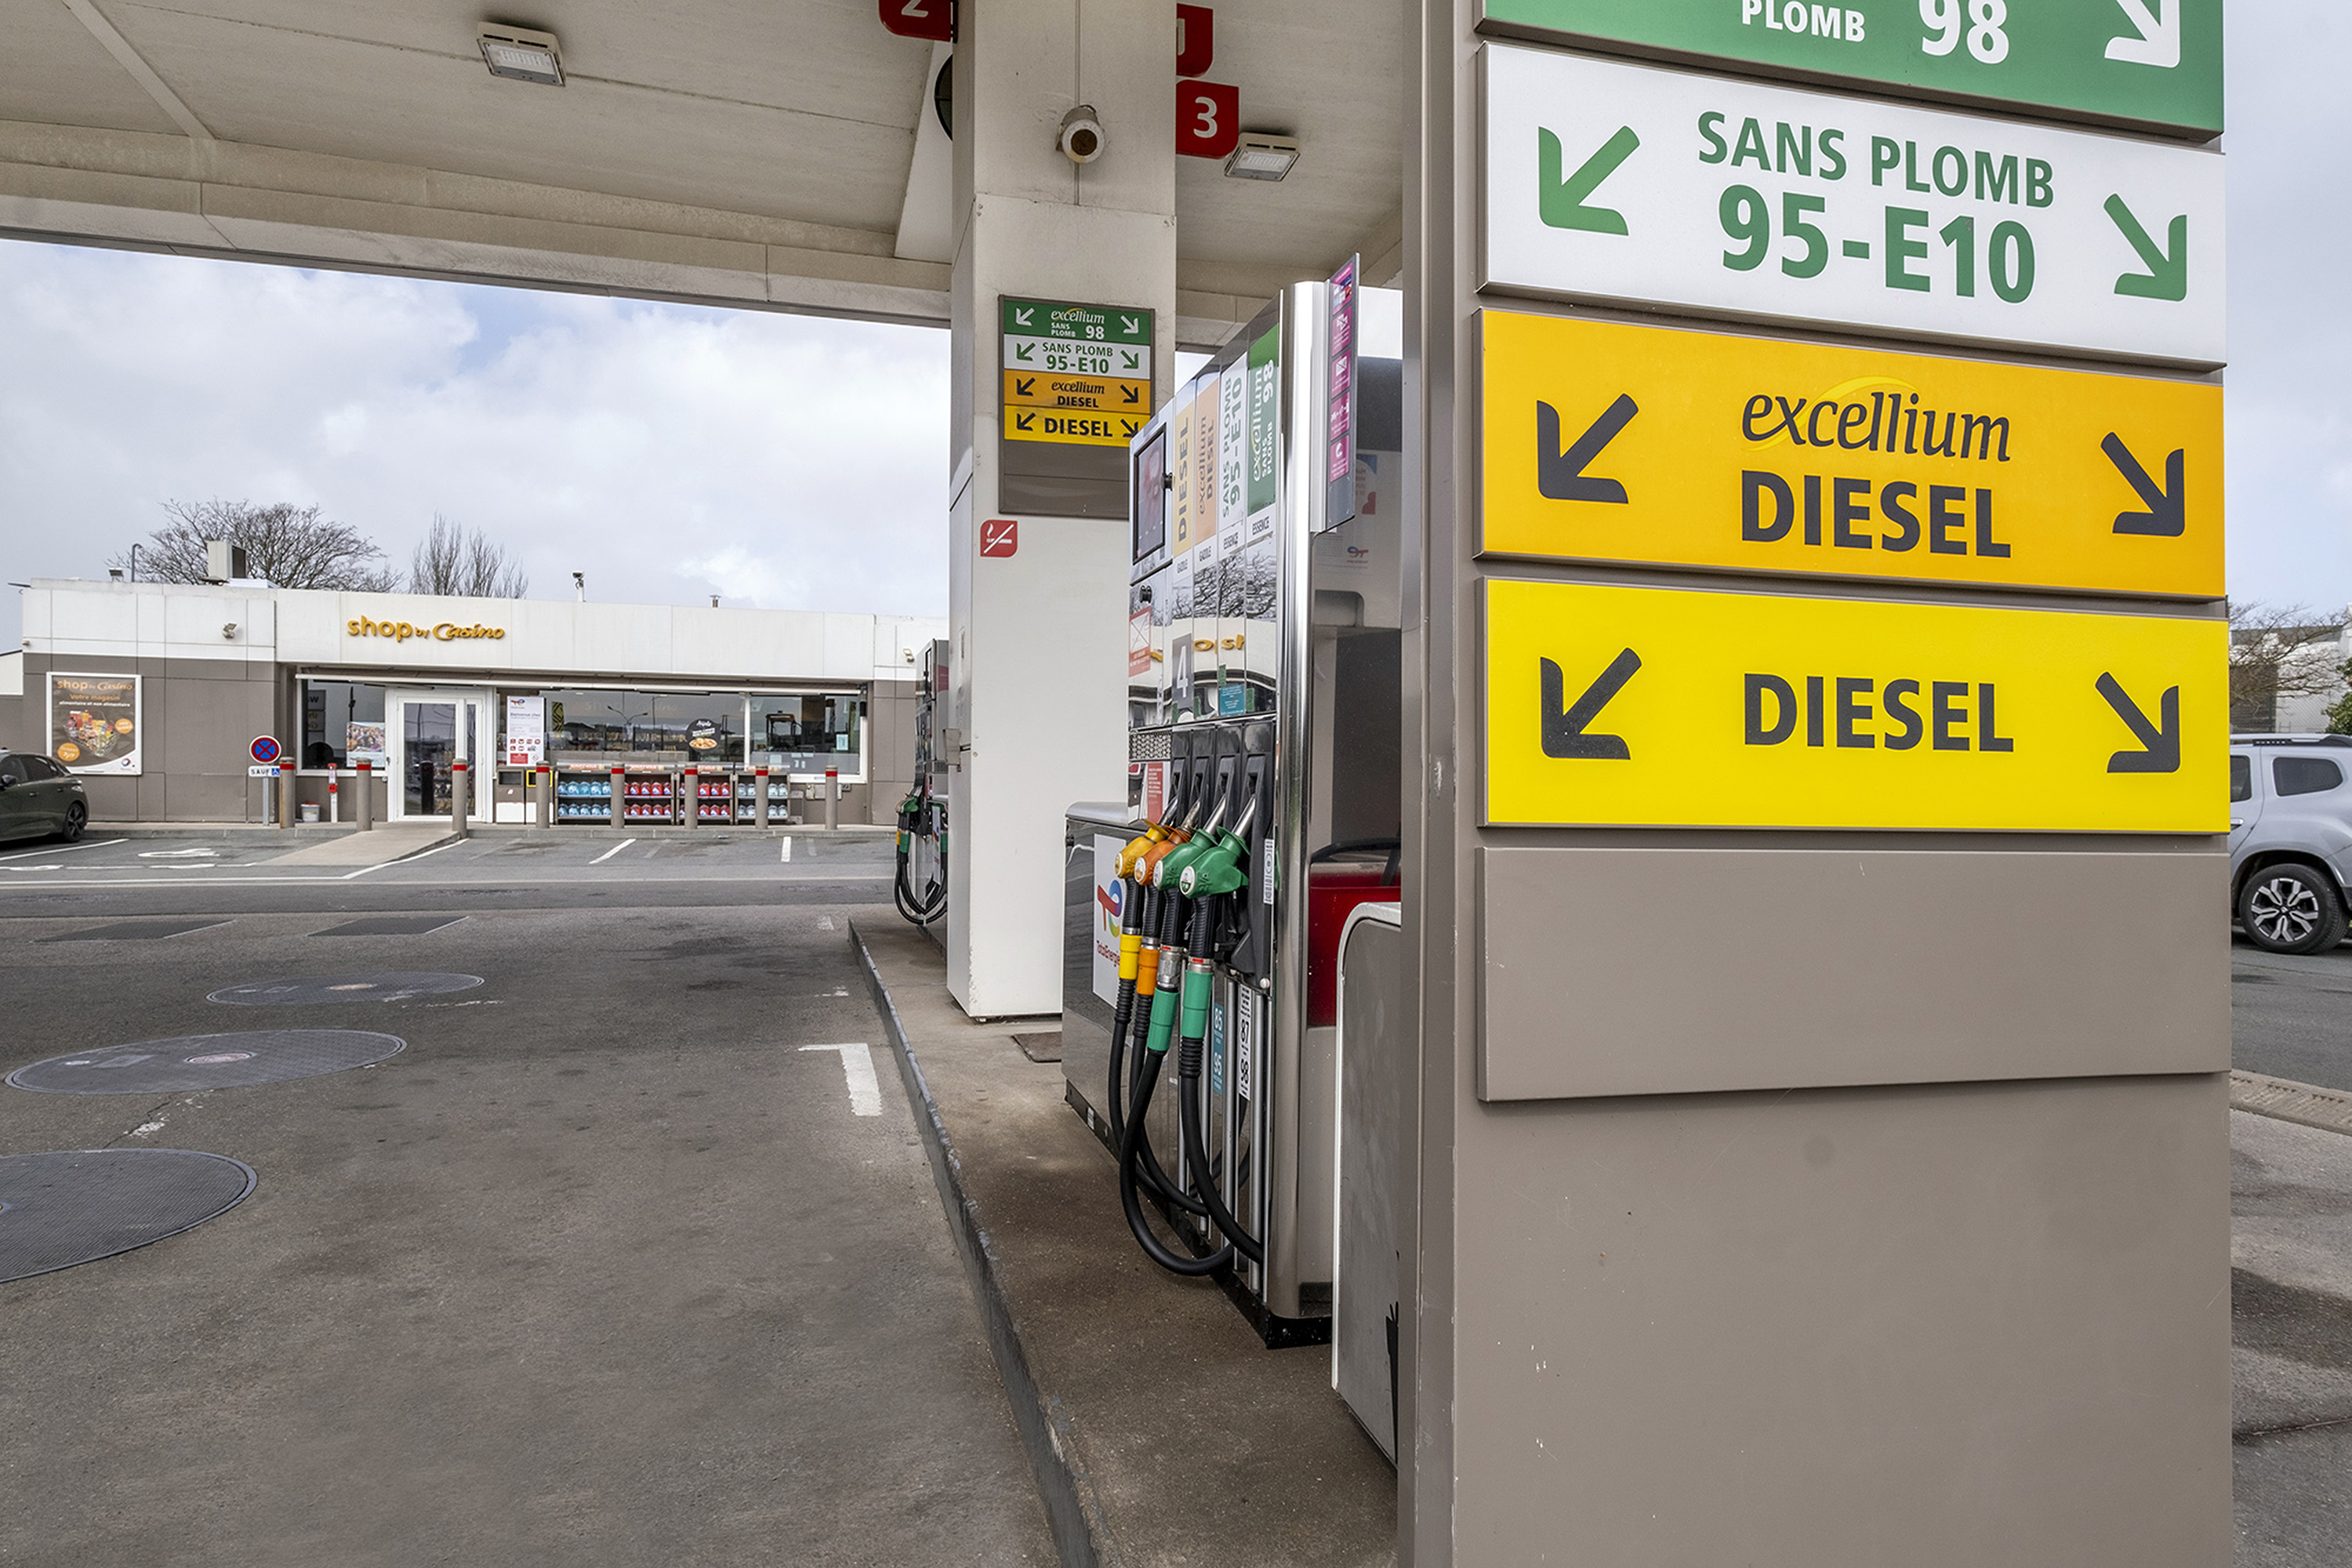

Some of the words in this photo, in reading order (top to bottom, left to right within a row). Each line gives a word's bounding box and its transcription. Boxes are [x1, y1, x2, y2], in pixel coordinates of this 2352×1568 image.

[1742, 0, 1865, 42] PLOMB
[1919, 0, 2009, 64] 98
[1192, 96, 1218, 139] 3
[1697, 111, 1847, 181] SANS
[1871, 136, 2055, 209] PLOMB
[1719, 184, 2037, 304] 95-E10
[1051, 310, 1105, 324] excellium
[1051, 329, 1076, 338] PLOMB
[1085, 325, 1105, 340] 98
[1043, 342, 1072, 354] SANS
[1075, 345, 1113, 357] PLOMB
[1046, 354, 1109, 374] 95-E10
[1051, 381, 1105, 394] excellium
[1057, 395, 1099, 408] DIESEL
[1262, 359, 1274, 403] 98
[1044, 417, 1113, 437] DIESEL
[1224, 377, 1232, 453] PLOMB
[1229, 376, 1243, 506] 95-E10
[1252, 367, 1262, 482] excellium
[1740, 391, 2011, 462] excellium
[1265, 422, 1273, 475] PLOMB
[1178, 417, 1189, 542] DIESEL
[1740, 470, 2012, 559] DIESEL
[347, 615, 414, 644] shop
[415, 626, 430, 639] by
[432, 623, 506, 641] Casino
[57, 680, 88, 691] shop
[97, 682, 132, 691] Casino
[1177, 645, 1189, 699] 4
[1743, 673, 2015, 753] DIESEL
